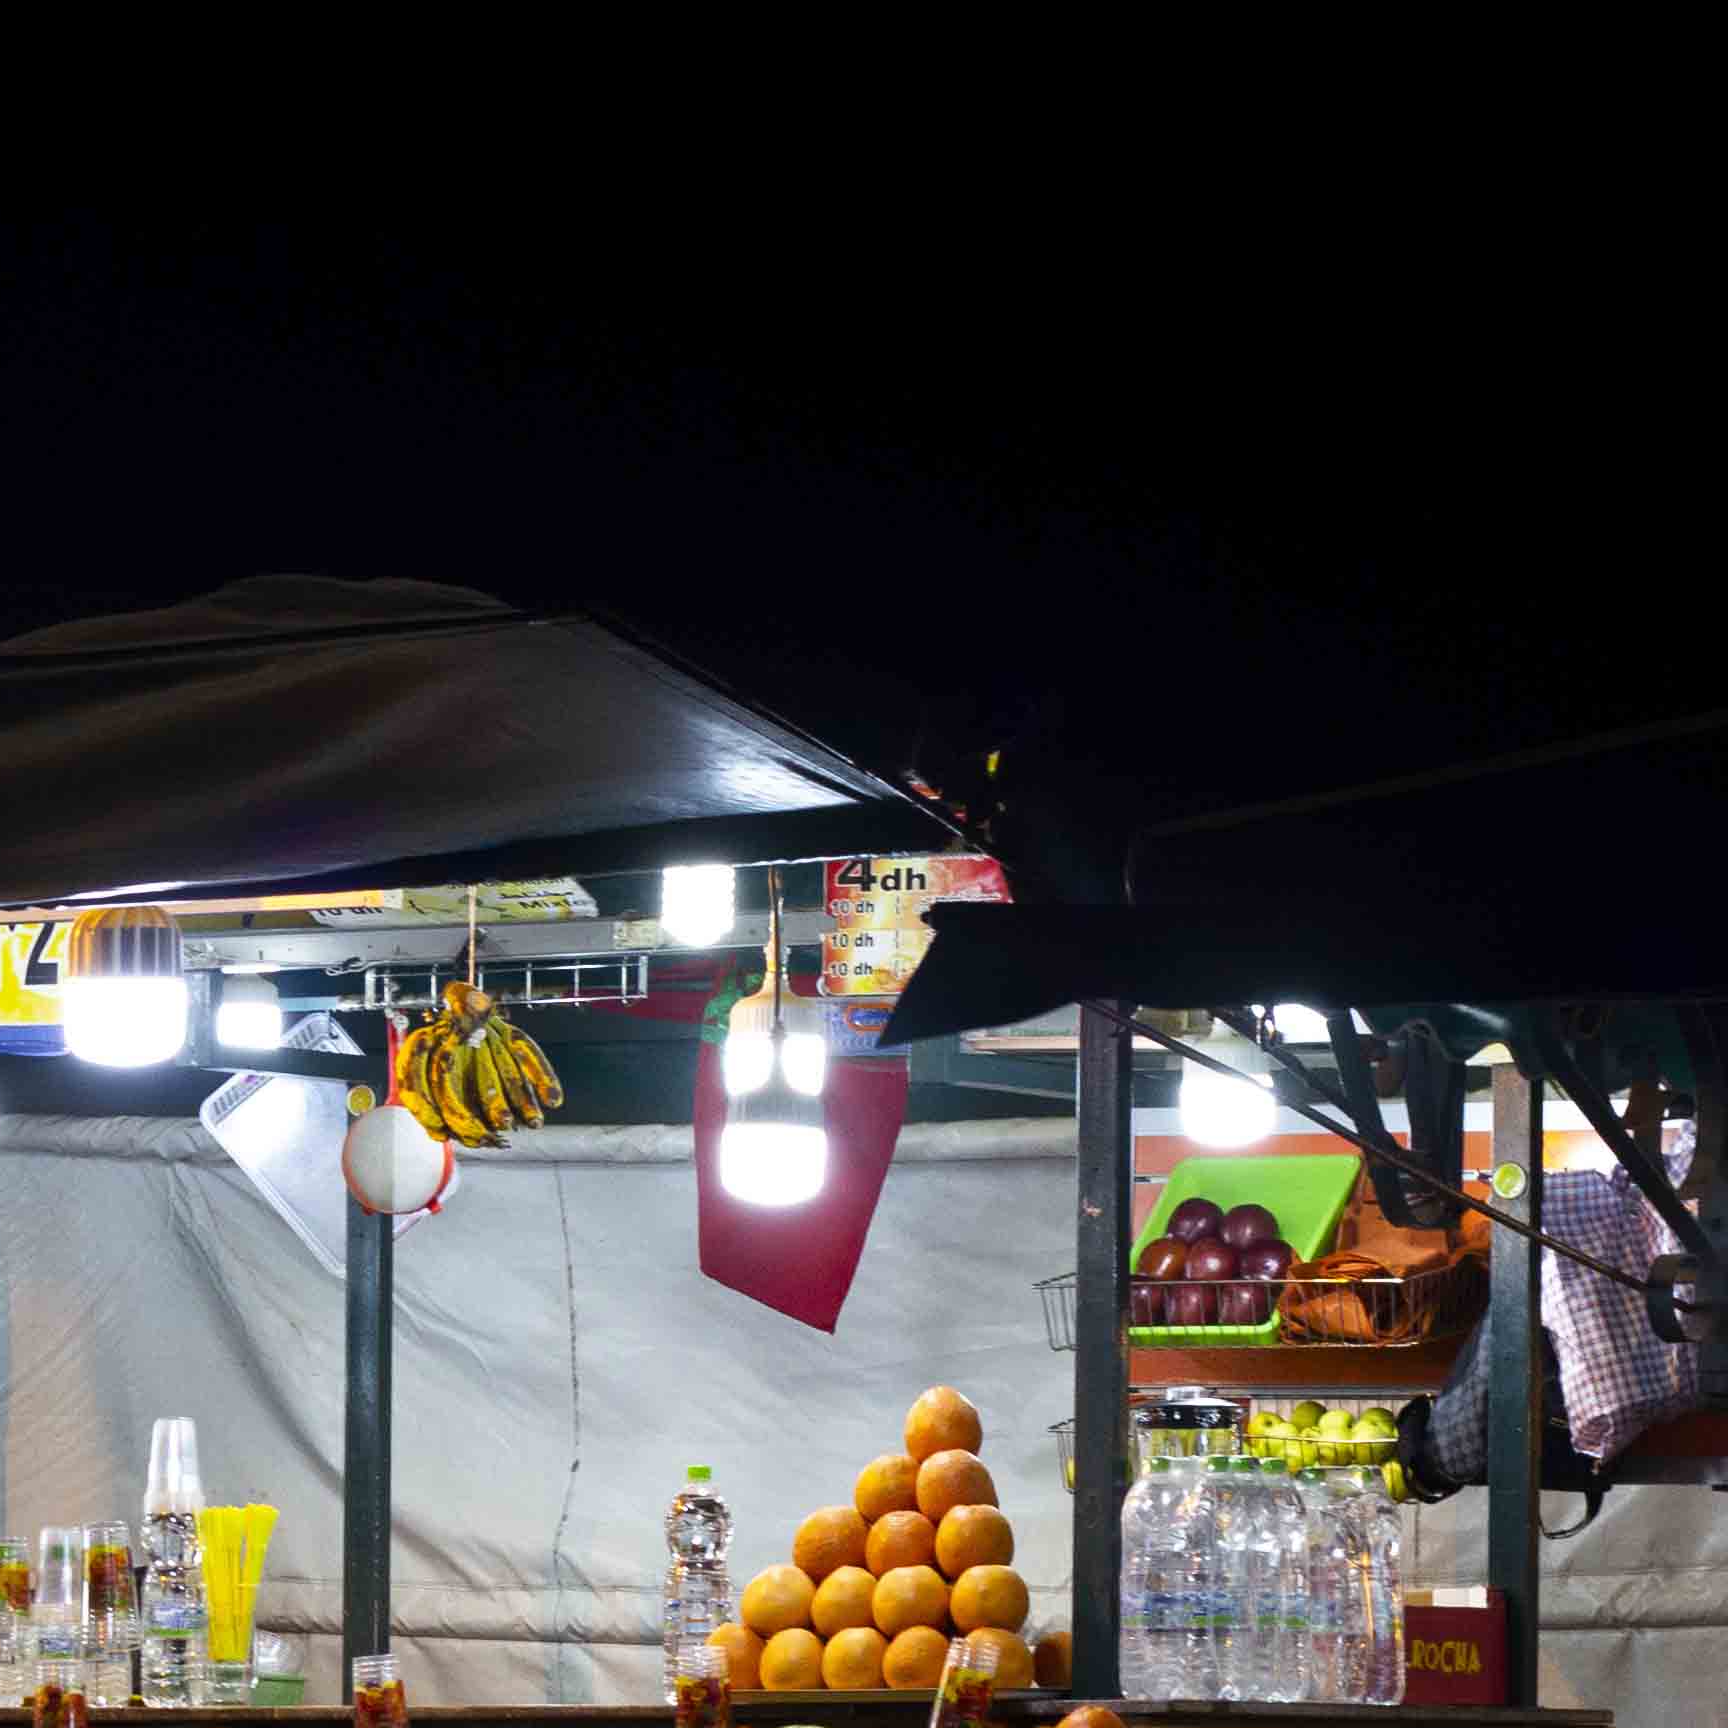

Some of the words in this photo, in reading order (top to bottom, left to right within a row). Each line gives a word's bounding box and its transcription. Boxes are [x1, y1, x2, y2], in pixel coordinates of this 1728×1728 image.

[856, 900, 875, 914] dh
[855, 933, 875, 948] dh
[853, 962, 873, 976] dh
